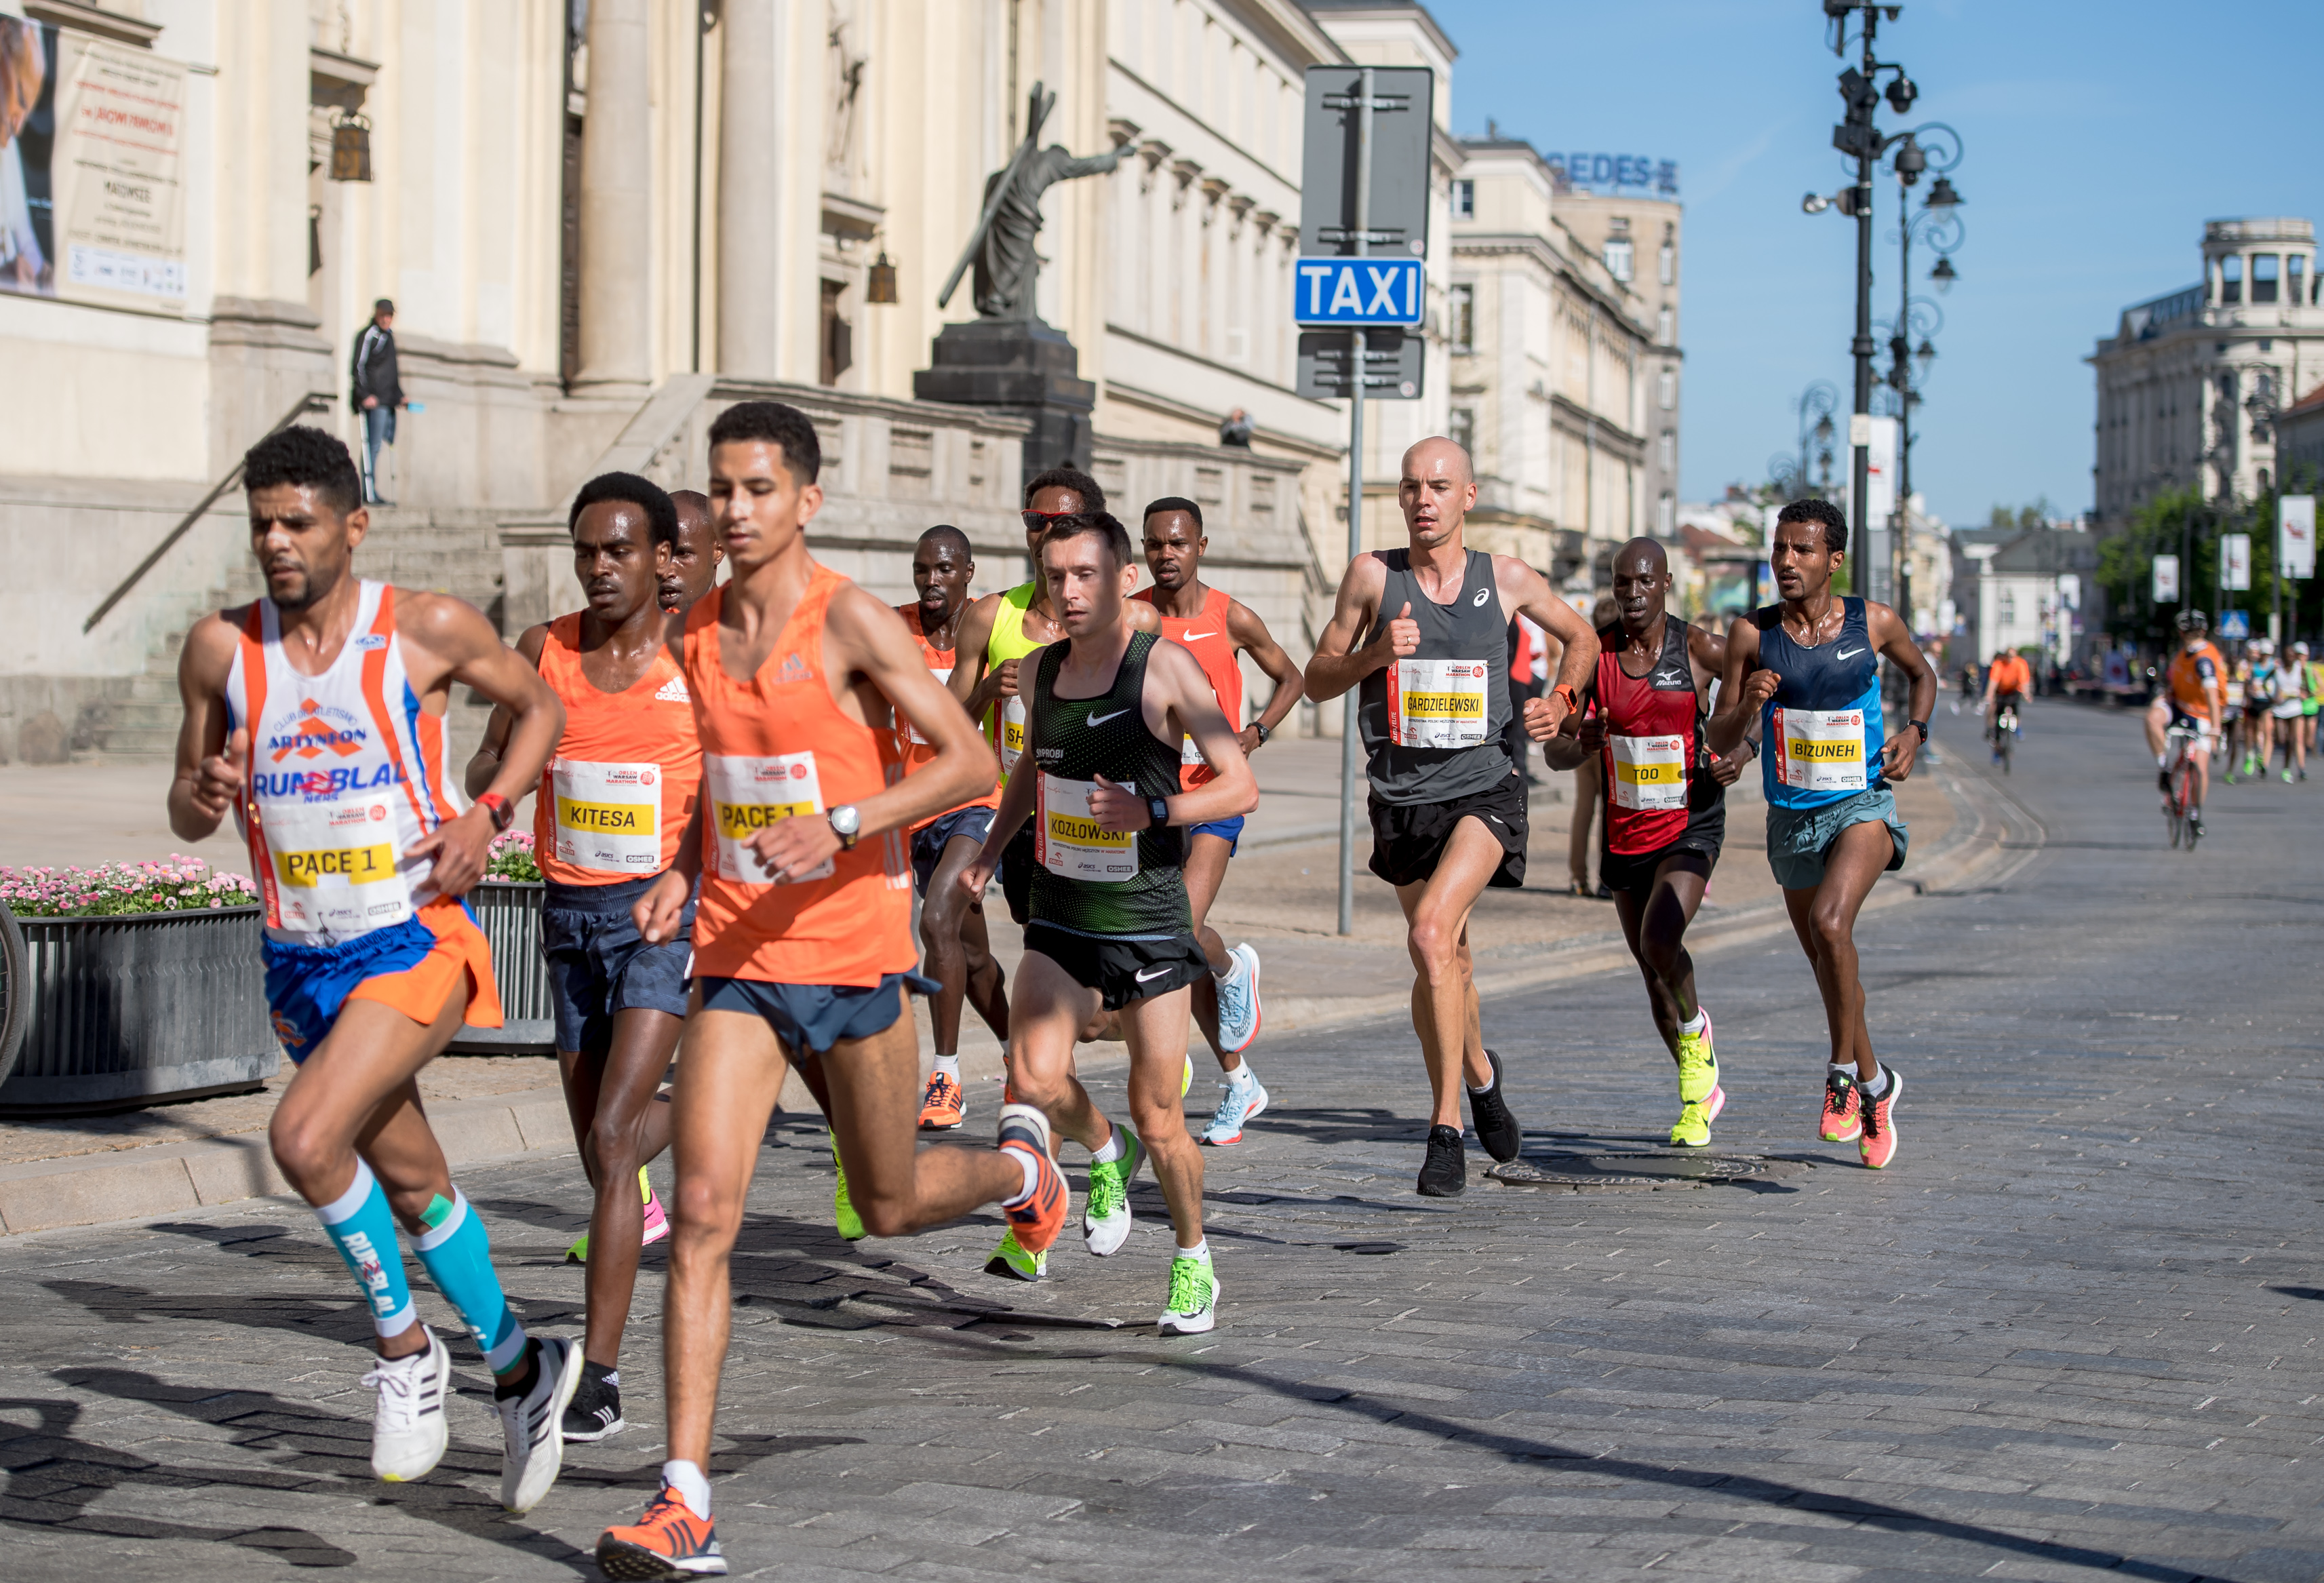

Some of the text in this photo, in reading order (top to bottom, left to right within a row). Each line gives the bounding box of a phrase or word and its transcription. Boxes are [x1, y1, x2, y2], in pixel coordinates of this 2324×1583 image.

[1300, 266, 1417, 316] TAXI
[1408, 697, 1479, 712] GARDZIELEWSKI
[1794, 743, 1855, 758] BIZUNEH
[1633, 768, 1659, 781] TOO
[328, 817, 366, 827] MARATHON
[336, 812, 366, 820] WARSAW
[570, 806, 635, 827] KITESA
[722, 804, 775, 829] PACE
[1051, 818, 1125, 841] KOZŁOWSKI
[287, 849, 377, 877] PACE 1
